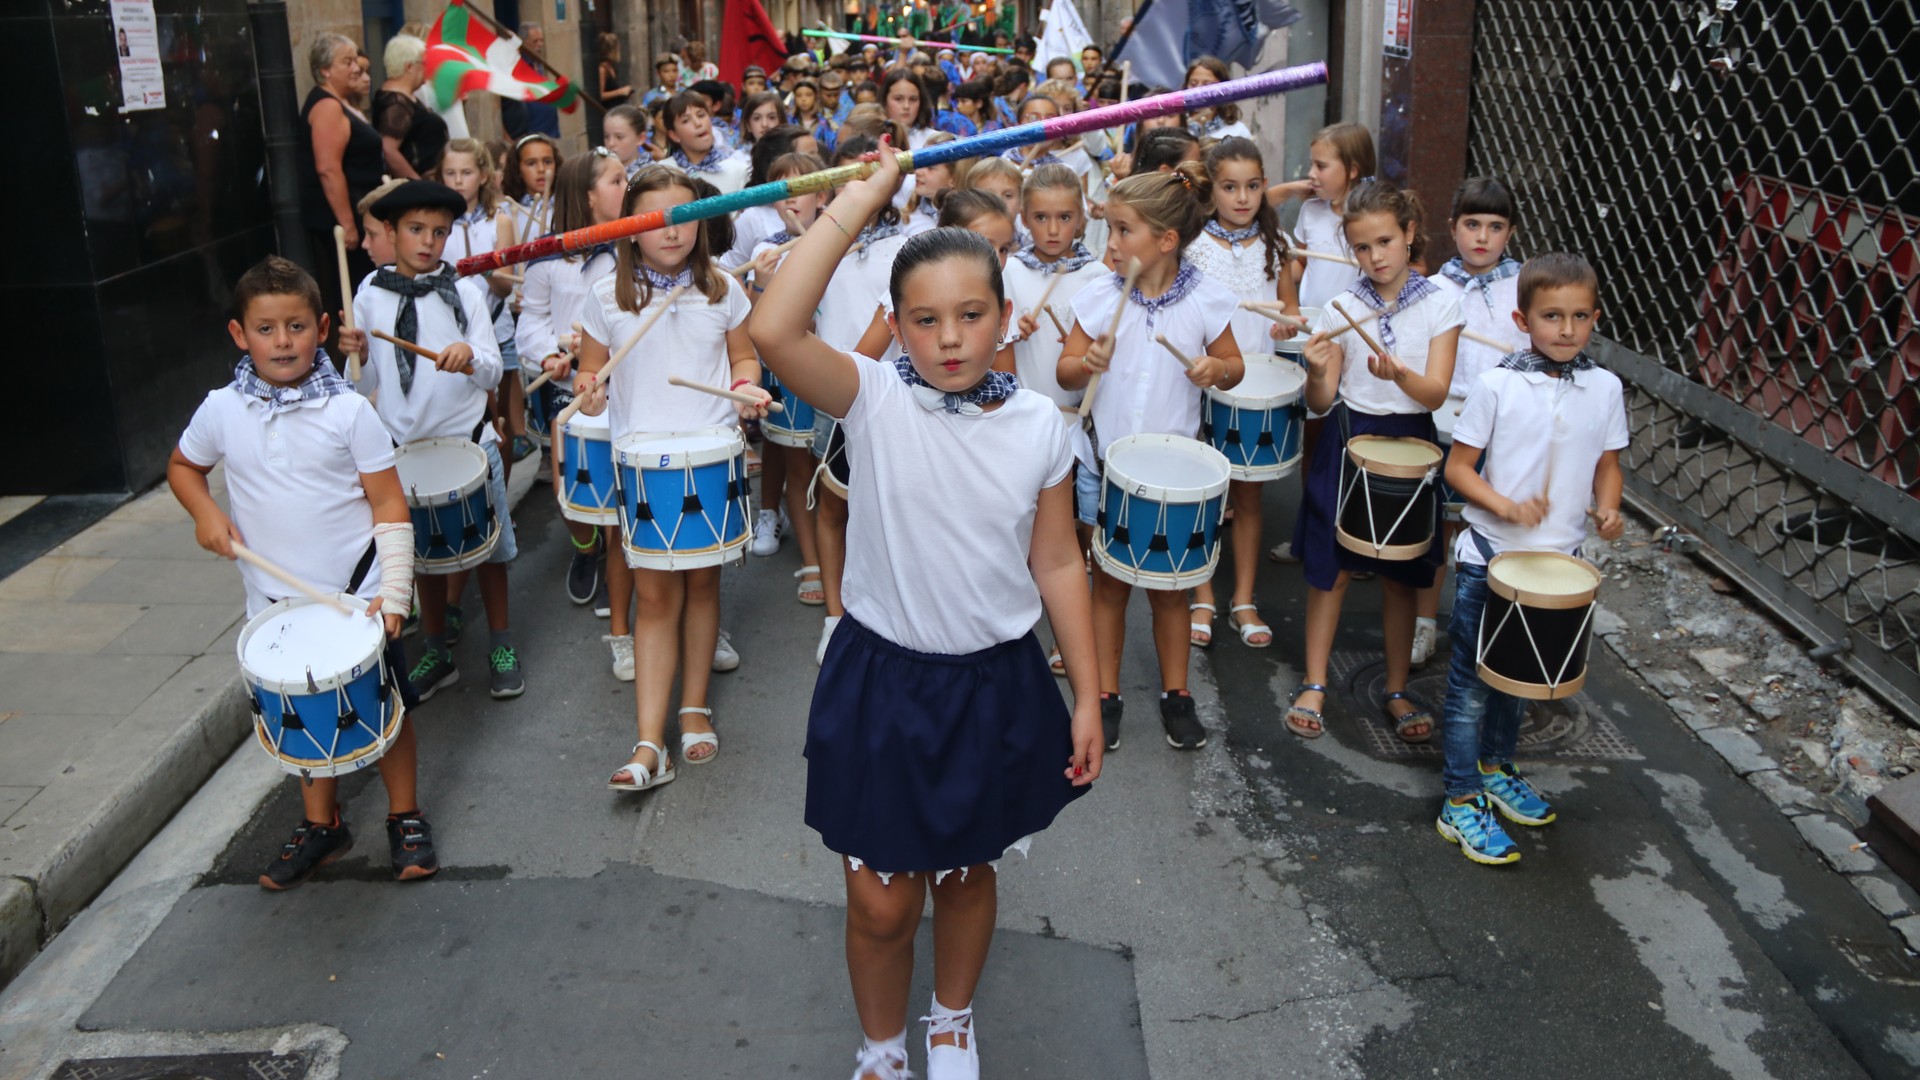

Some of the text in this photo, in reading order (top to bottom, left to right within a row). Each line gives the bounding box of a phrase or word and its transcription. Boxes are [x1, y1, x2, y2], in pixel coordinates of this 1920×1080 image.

[659, 455, 670, 466] B
[449, 490, 458, 502] B
[1136, 484, 1147, 496] B
[352, 665, 362, 678] B
